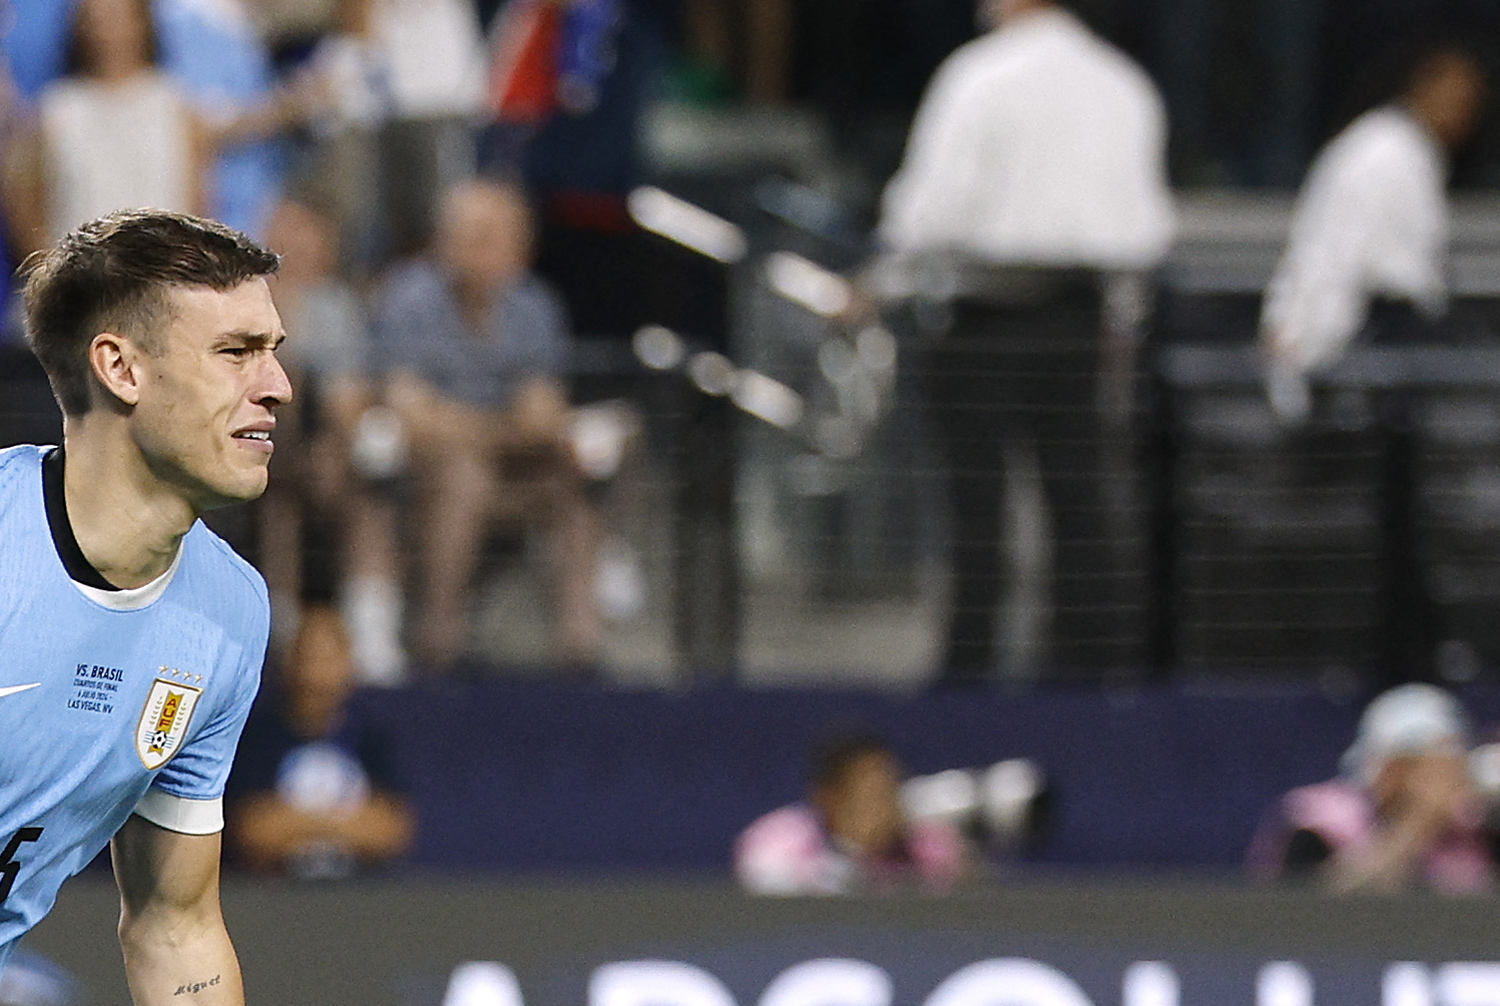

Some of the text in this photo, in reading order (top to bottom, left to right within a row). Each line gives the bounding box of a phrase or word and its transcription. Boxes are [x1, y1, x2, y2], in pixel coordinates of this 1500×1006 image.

[76, 664, 123, 681] VS. BRASIL
[67, 699, 80, 709] LAS
[159, 698, 177, 727] AUF
[174, 974, 220, 996] Miguel
